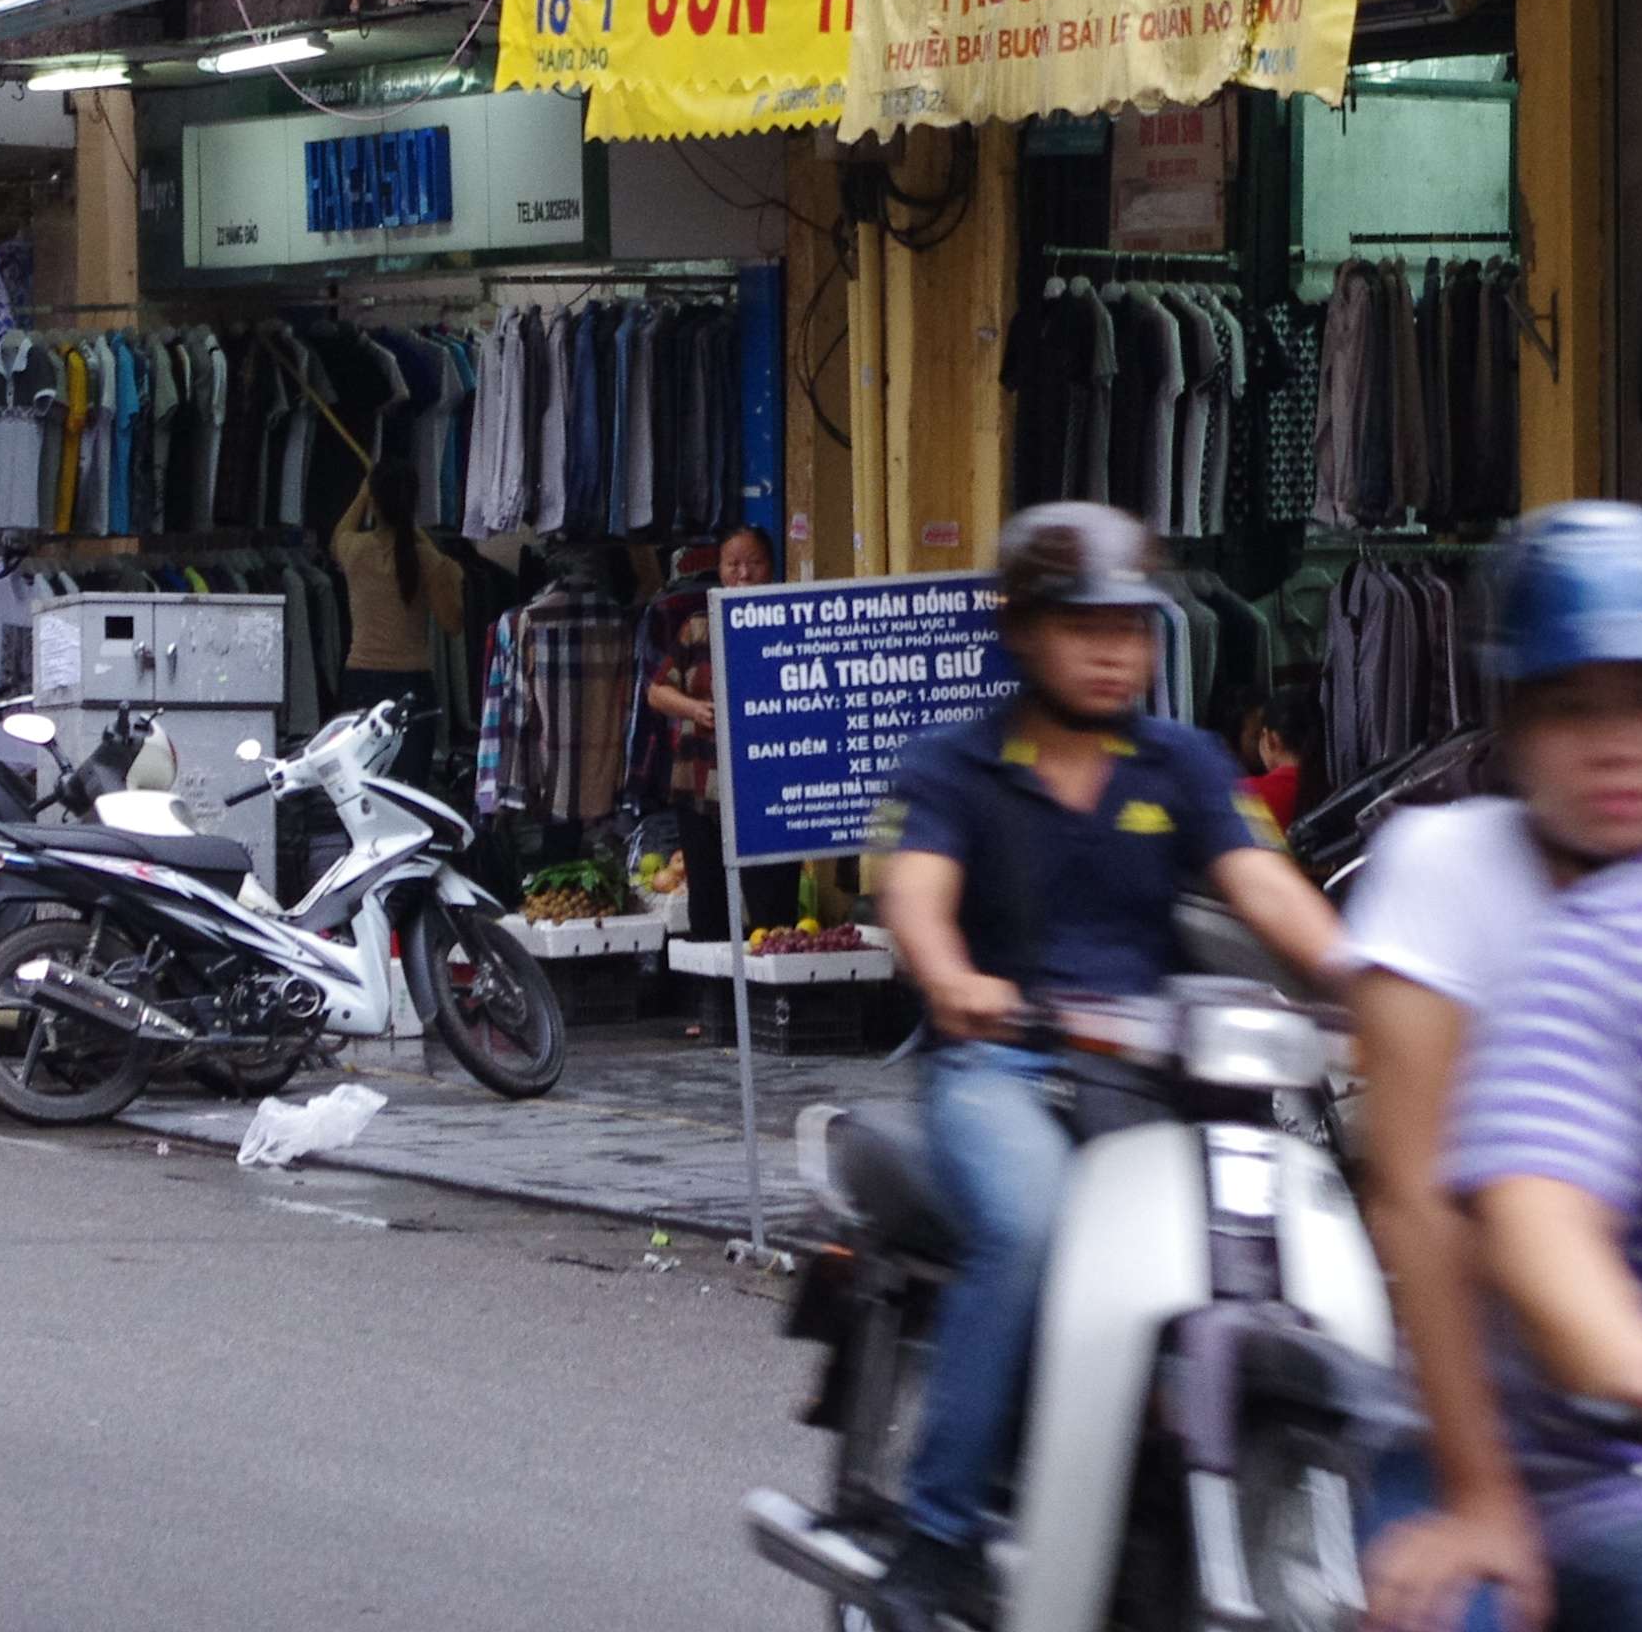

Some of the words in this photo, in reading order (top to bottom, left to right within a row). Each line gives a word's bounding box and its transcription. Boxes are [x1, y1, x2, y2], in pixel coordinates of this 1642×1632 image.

[730, 602, 786, 628] CÔNG
[791, 602, 814, 624] TY
[891, 619, 917, 631] KHU
[843, 640, 859, 652] XE
[780, 656, 828, 692] GIÁ
[835, 652, 927, 687] TRÔNG
[935, 643, 985, 680] GIỮ
[744, 700, 782, 716] BAN
[845, 693, 867, 709] XE
[847, 715, 871, 731] XE
[747, 743, 786, 760] BAN
[789, 736, 828, 757] ĐÊM
[847, 736, 870, 753] XE
[849, 758, 873, 774] XE
[876, 754, 903, 772] MÁ
[864, 779, 890, 794] THEO
